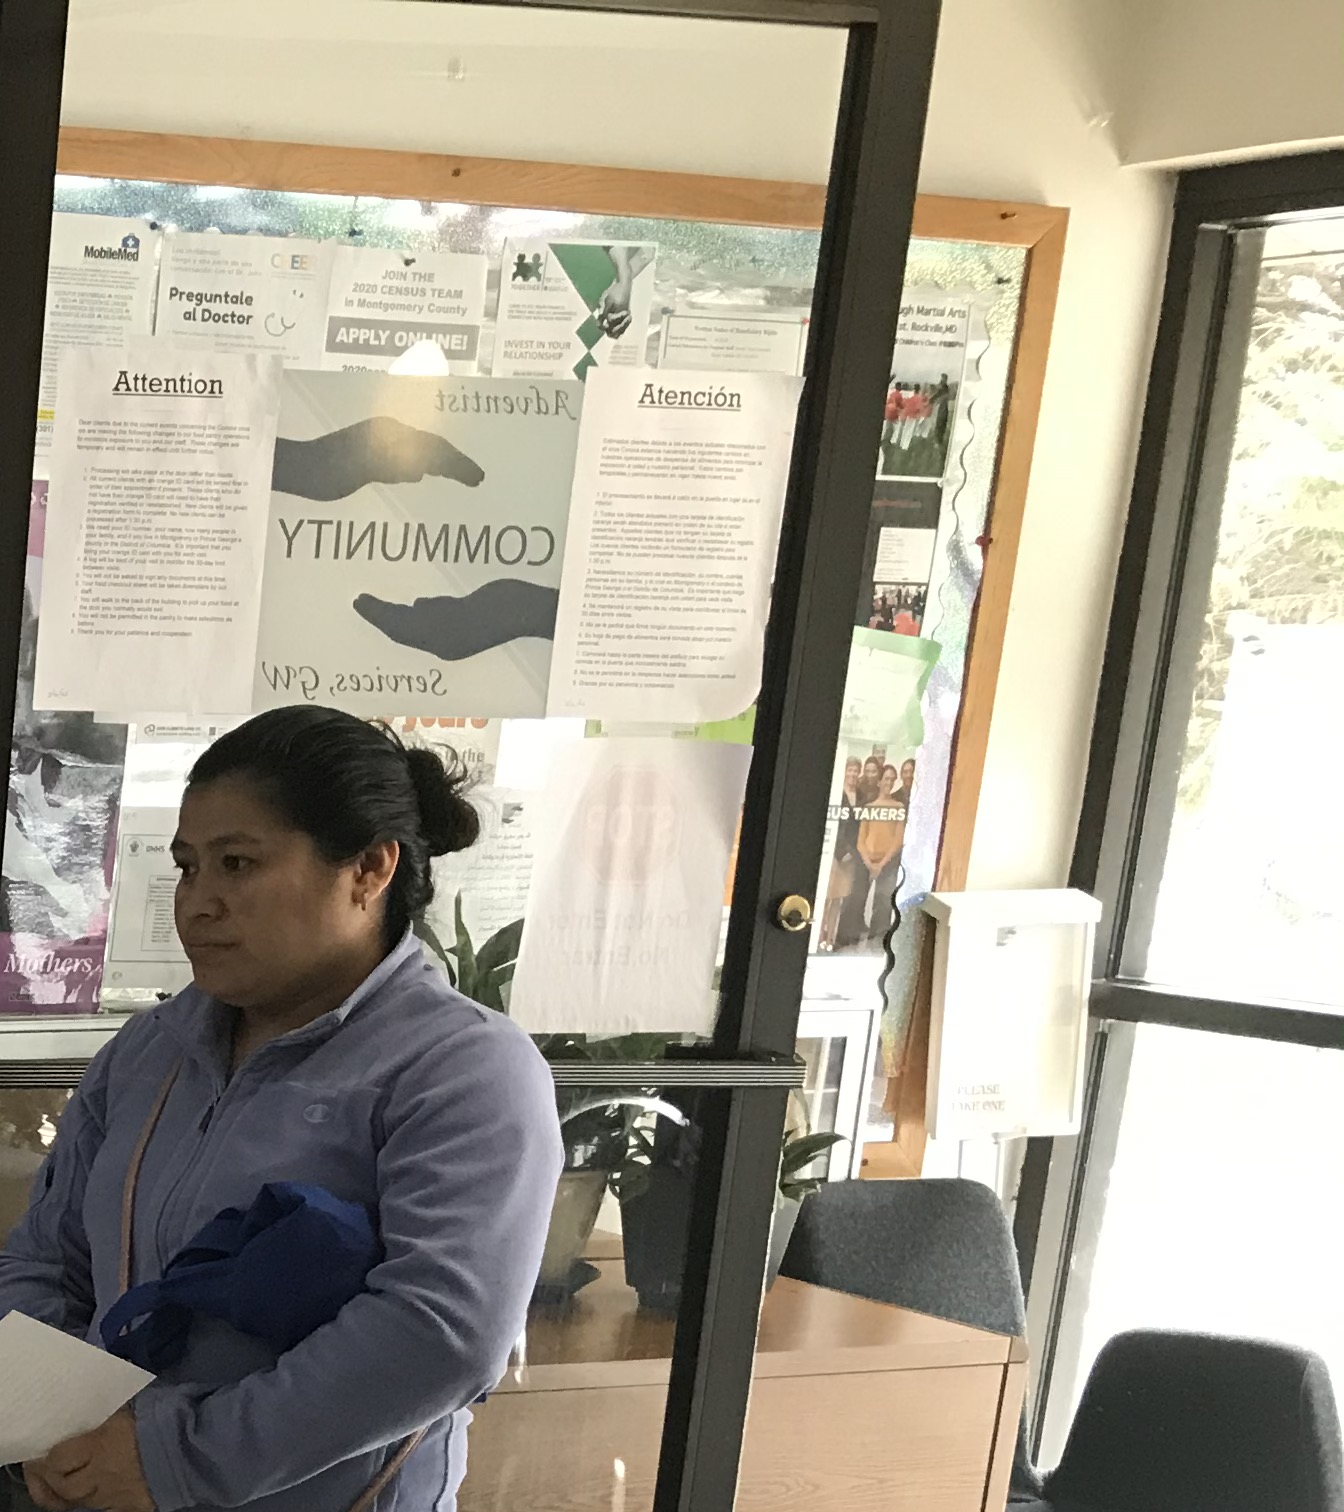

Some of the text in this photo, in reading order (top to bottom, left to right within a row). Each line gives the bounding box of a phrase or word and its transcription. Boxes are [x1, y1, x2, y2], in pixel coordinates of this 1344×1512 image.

[84, 245, 139, 262] MobileMed
[381, 270, 435, 283] JOIN THE
[169, 287, 254, 307] Preguntale
[352, 283, 463, 299] 2020 CENSUS TEAM
[183, 307, 254, 325] al Doctor
[345, 298, 467, 317] in Montgomery County
[916, 305, 946, 316] Martial
[947, 307, 966, 319] Arts
[335, 327, 390, 345] APPLY
[504, 340, 571, 350] INVEST IN YOUR
[503, 350, 564, 361] RELATIONSHIP
[112, 371, 223, 394] Attention
[638, 383, 742, 408] Atención
[853, 806, 907, 821] TAKERS
[3, 950, 93, 975] Mothers
[982, 1101, 1005, 1112] ONE
